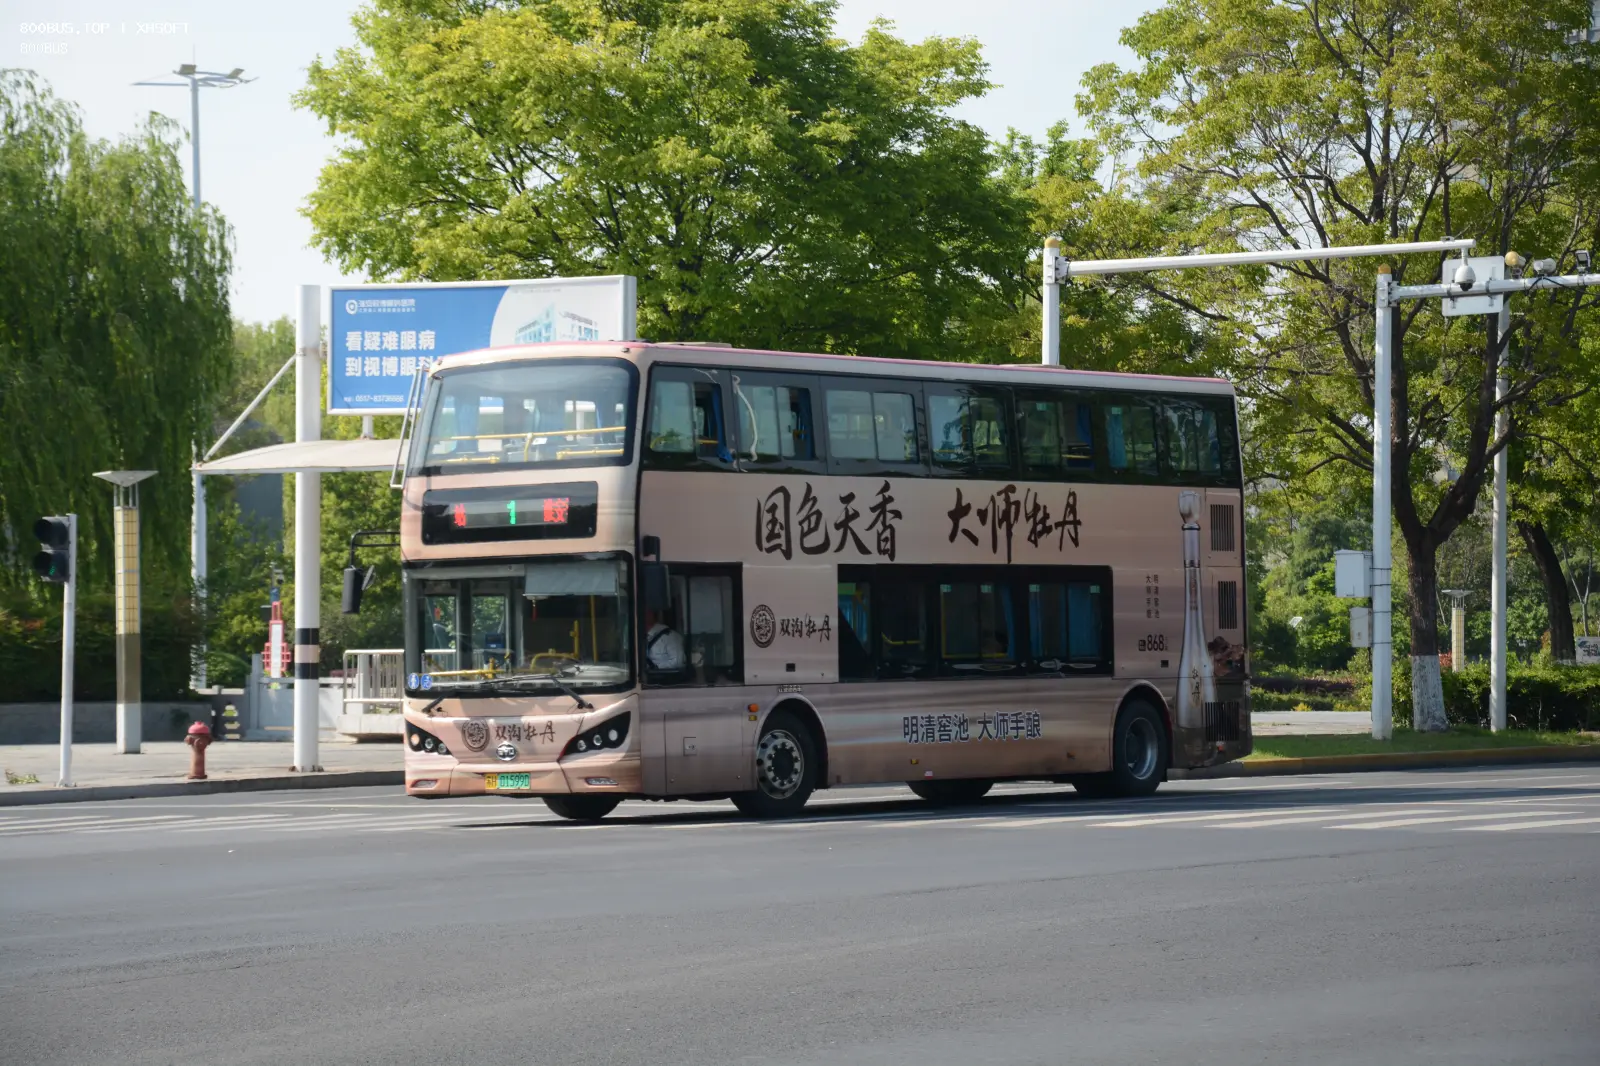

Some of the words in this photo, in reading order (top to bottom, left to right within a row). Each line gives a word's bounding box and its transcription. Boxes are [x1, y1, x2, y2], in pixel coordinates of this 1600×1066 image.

[346, 331, 436, 351] 看疑难眼病
[507, 500, 516, 525] 1
[755, 480, 903, 562] 国色天香
[947, 484, 1082, 564] 大师牡丹
[779, 612, 832, 642] 双沟牡丹
[494, 720, 556, 745] 双沟牡丹
[902, 713, 970, 744] 明清窖池
[977, 710, 1042, 741] 大师手酿
